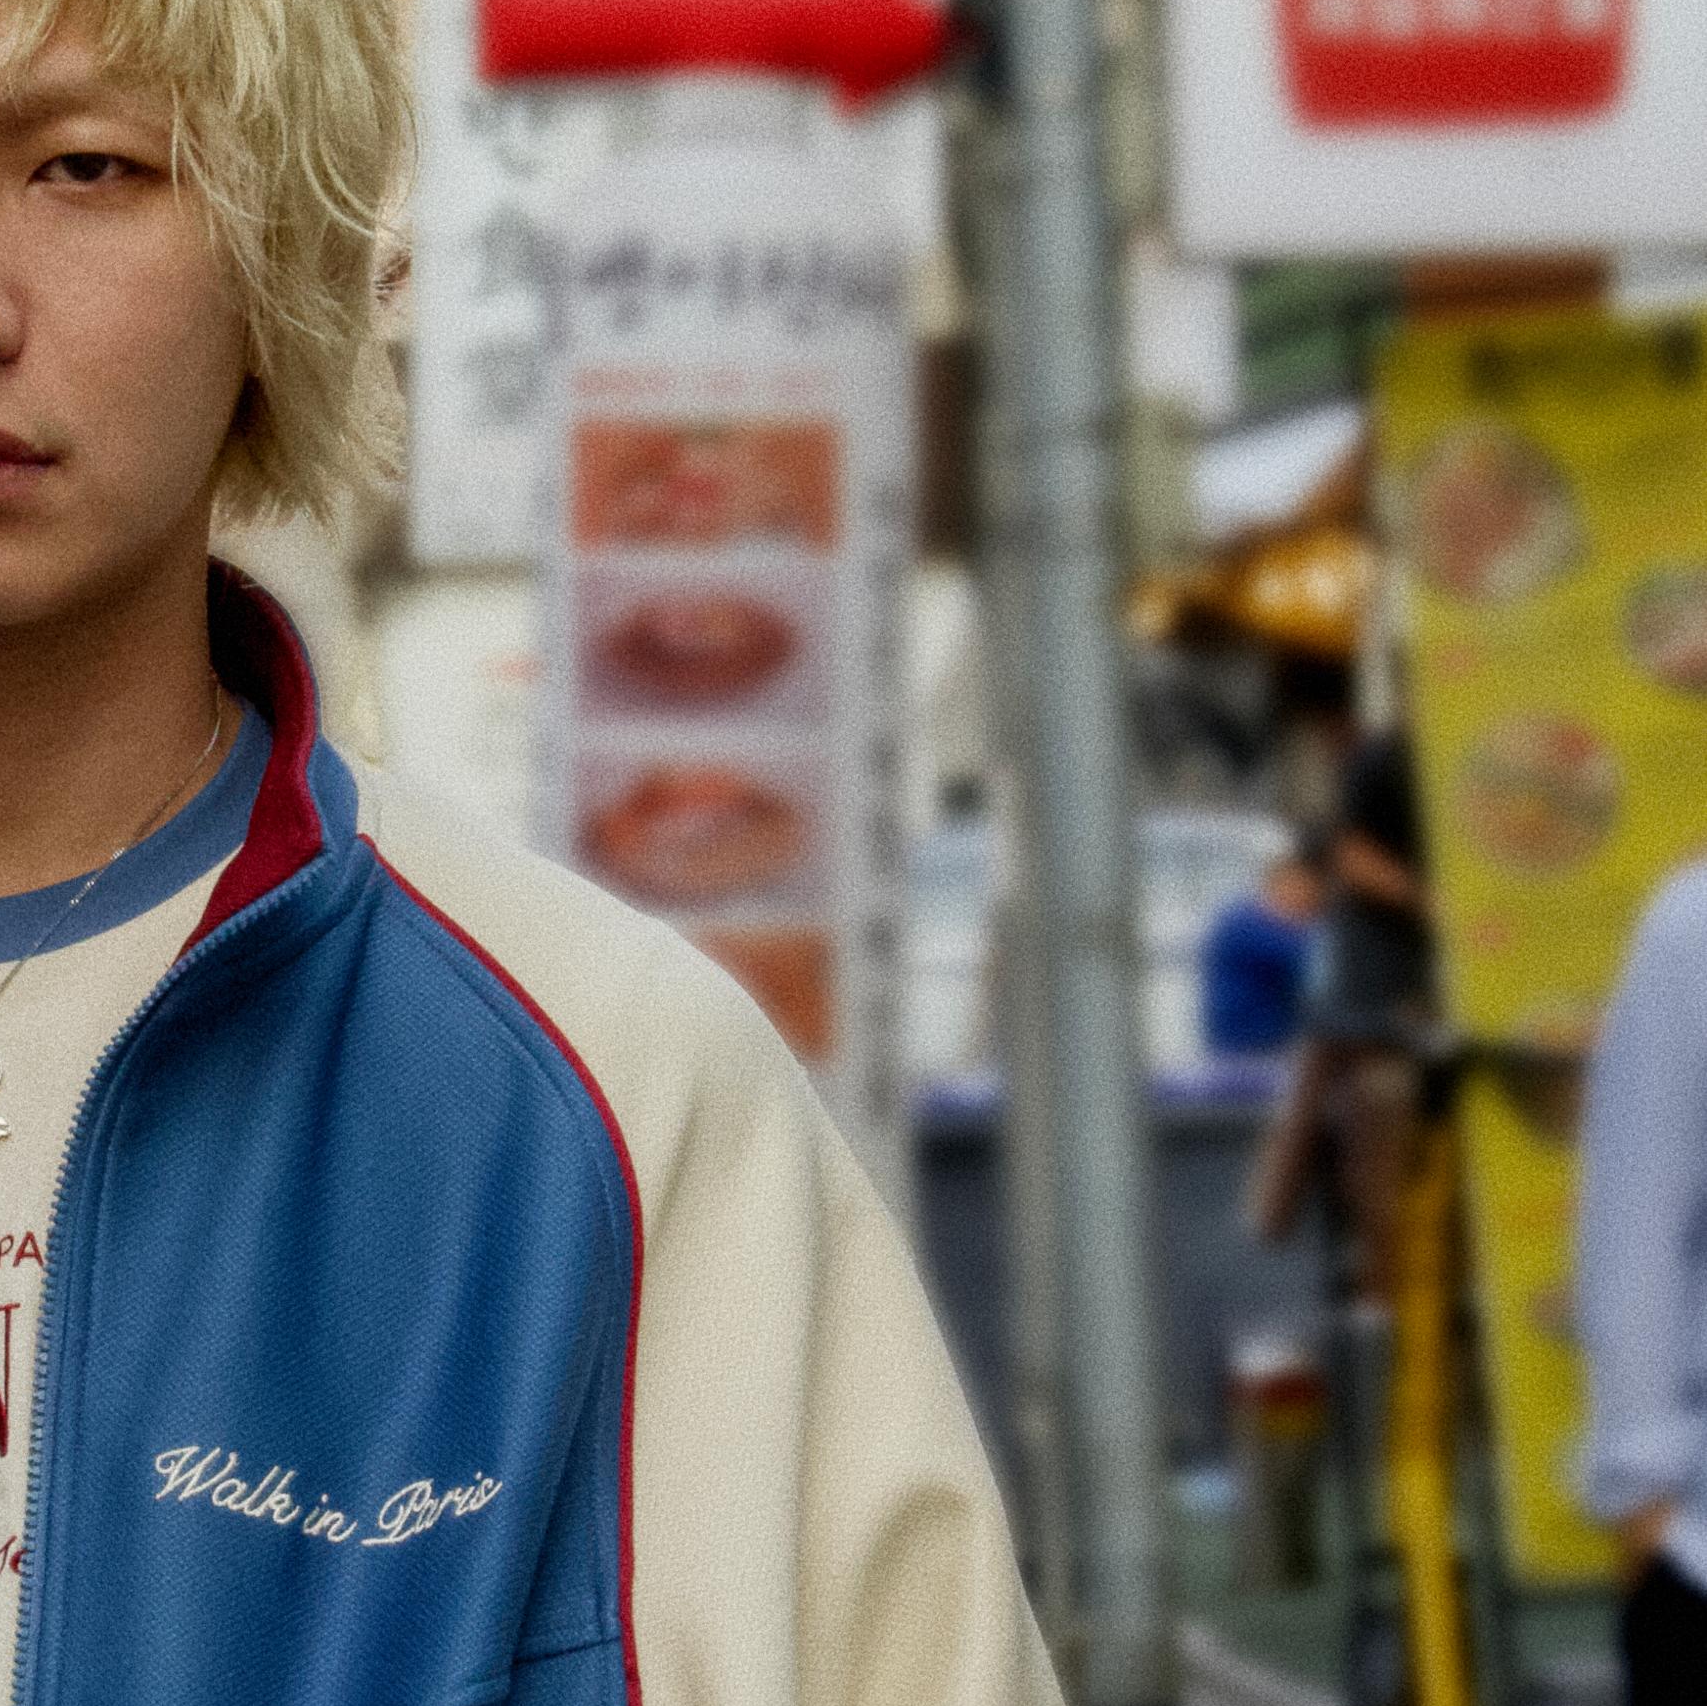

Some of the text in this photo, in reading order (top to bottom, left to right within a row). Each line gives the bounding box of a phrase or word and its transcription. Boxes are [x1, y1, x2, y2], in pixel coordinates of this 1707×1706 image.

[155, 1445, 503, 1546] Walk in Paris
